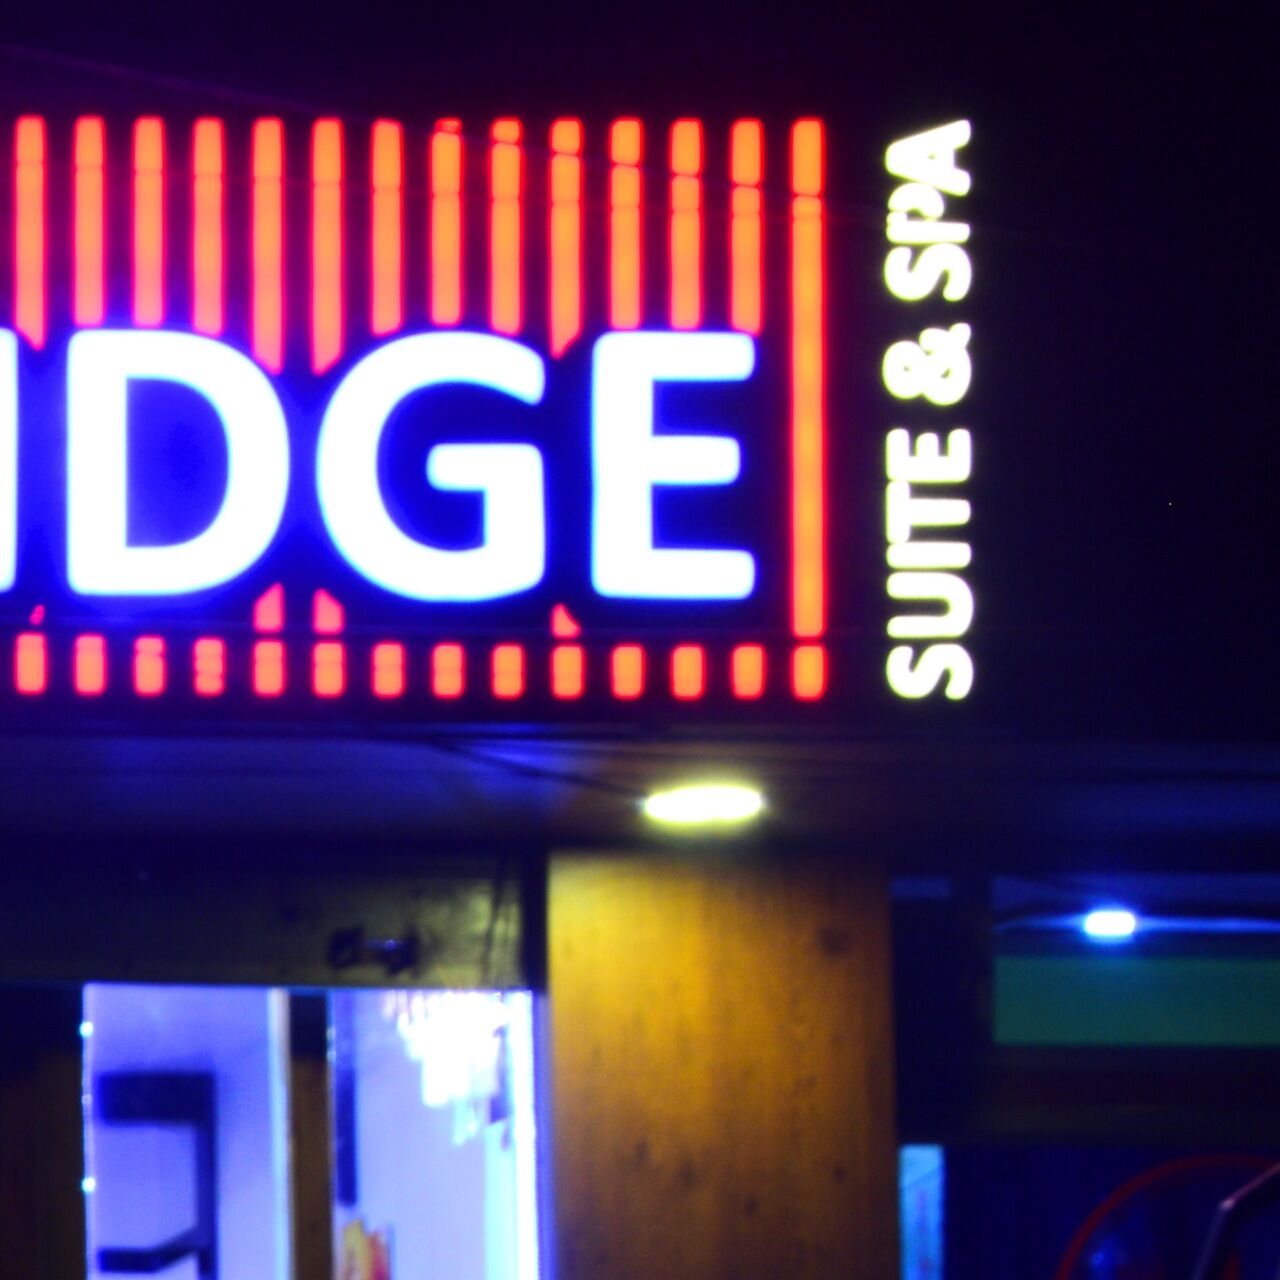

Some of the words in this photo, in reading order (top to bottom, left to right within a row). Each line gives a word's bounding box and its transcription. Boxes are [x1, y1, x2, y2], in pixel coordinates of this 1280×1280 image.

[884, 118, 974, 302] SPA
[882, 321, 973, 406] &
[885, 426, 975, 700] SUITE
